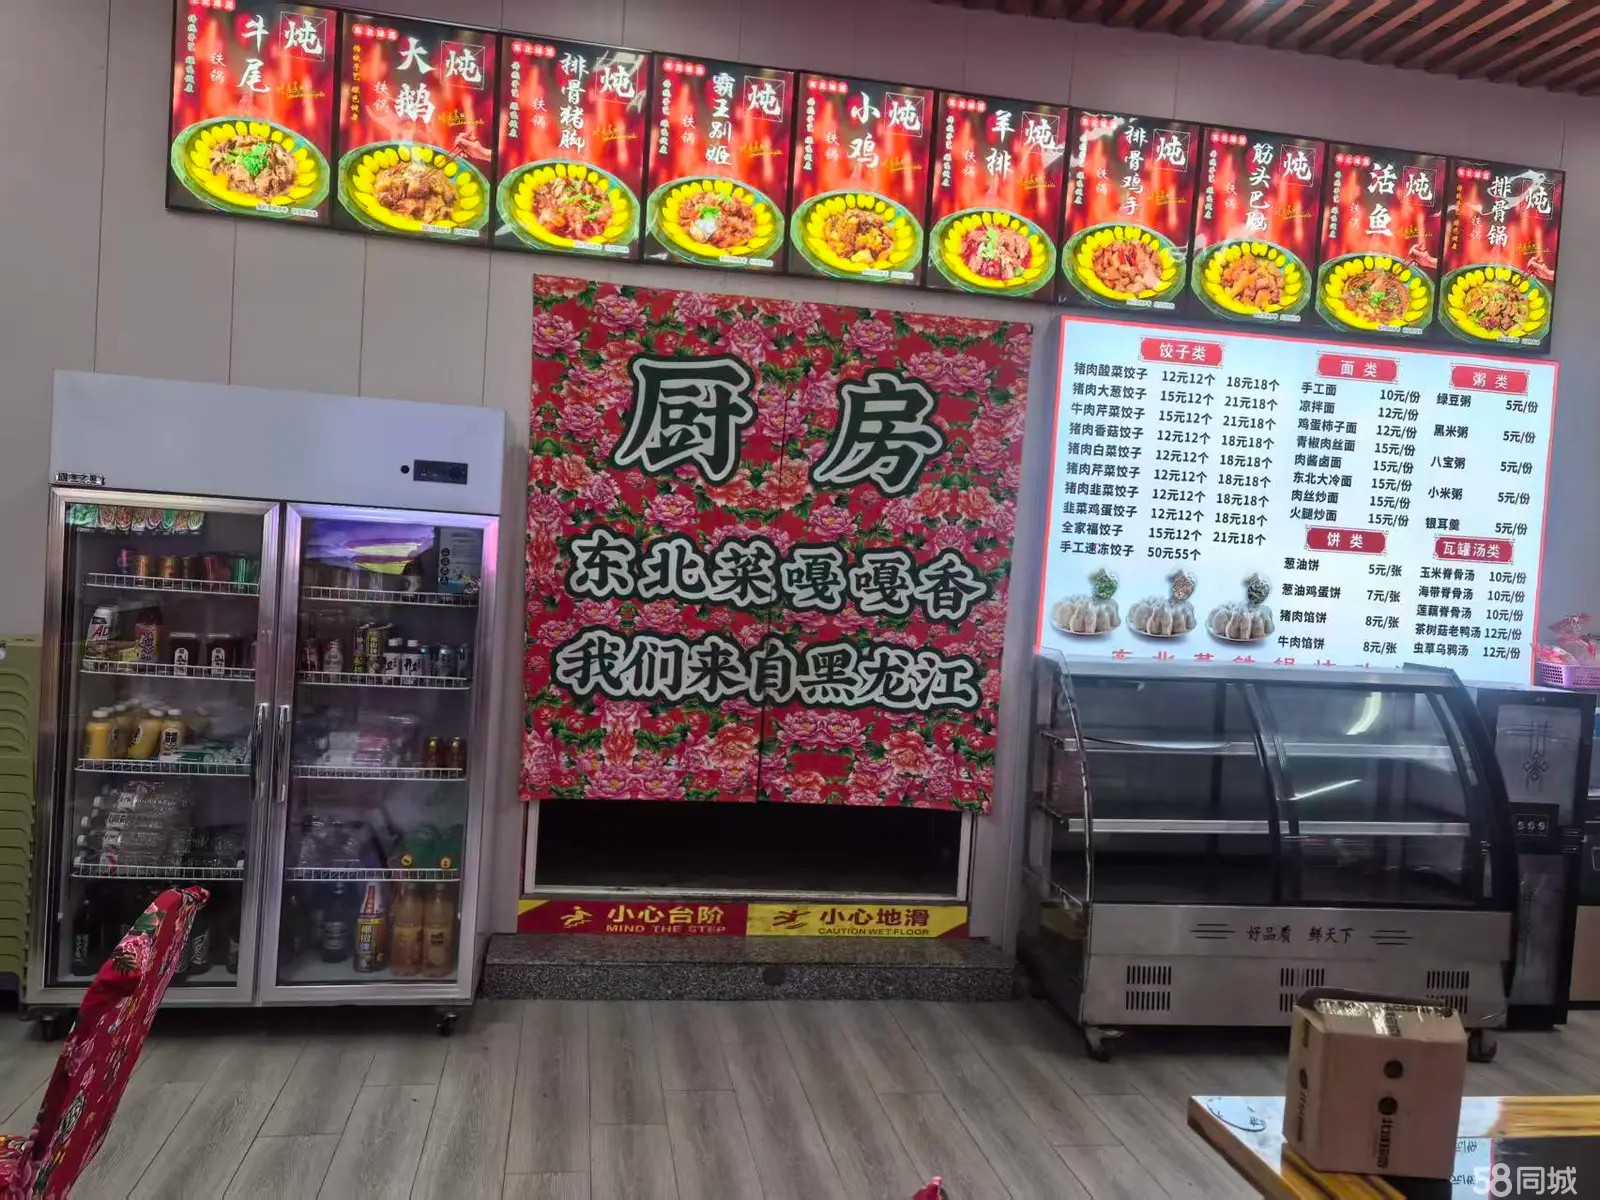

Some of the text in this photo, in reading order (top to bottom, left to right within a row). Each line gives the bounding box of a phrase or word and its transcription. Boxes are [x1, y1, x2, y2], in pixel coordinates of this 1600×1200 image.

[284, 20, 323, 55] 炖
[237, 15, 270, 93] 牛尾
[444, 48, 481, 82] 炖
[394, 36, 436, 125] 大鹅
[600, 65, 635, 98] 炖
[747, 82, 781, 116] 炖
[706, 72, 735, 165] 霸王别姬
[889, 99, 921, 131] 炖
[848, 91, 881, 169] 小鸡
[1025, 118, 1057, 149] 炖
[985, 109, 1016, 181] 羊排
[1156, 135, 1186, 166] 炖
[1283, 151, 1312, 180] 炖
[1405, 172, 1433, 200] 炖
[1366, 162, 1397, 237] 活鱼
[1525, 186, 1551, 214] 炖
[1487, 176, 1513, 247] 排骨锅
[1158, 343, 1207, 362] 饺子类
[1074, 362, 1280, 392] 猪肉酸菜饺子 12元12个 18元18个
[1340, 359, 1377, 377] 面类
[1473, 371, 1508, 389] 粥类
[1072, 382, 1278, 412] 猪肉大葱饺子 15元12个 21元18个
[1301, 382, 1421, 404] 手工面 10元/份
[1437, 392, 1538, 414] 绿豆粥 5元/份
[1071, 402, 1276, 431] 牛肉芹菜饺子 15元12个 21元18个
[1299, 400, 1419, 421] 凉拌面 12元/份
[613, 355, 945, 496] 厨房
[1069, 422, 1275, 451] 猪肉香菇饺子 12元12个 18元18个
[1297, 418, 1417, 439] 鸡蛋柿子面 12元/份
[1434, 424, 1536, 444] 黑米粥 5元/份
[1068, 442, 1273, 470] 猪肉白菜饺子 12元12个 18元18个
[1296, 435, 1416, 457] 青椒肉丝面 15元/份
[1295, 454, 1414, 474] 肉酱卤面 15元/份
[1431, 455, 1533, 475] 八宝粥 5元/份
[1066, 462, 1271, 489] 猪肉芹菜饺子 12元12个 18元18个
[1293, 471, 1412, 493] 东北大冷面 15元/份
[1065, 481, 1269, 508] 猪肉韭菜饺子 12元12个 18元18个
[1291, 490, 1411, 510] 肉丝炒面 15元/份
[1428, 486, 1530, 505] 小米粥 5元/份
[1063, 501, 1268, 528] 韭菜鸡蛋饺子 12元12个 18元18个
[1290, 507, 1409, 528] 火腿炒面 15元/份
[1062, 521, 1266, 547] 全家福饺子 15元12个 21元18个
[1425, 517, 1528, 536] 银耳羹 5元/份
[1060, 541, 1201, 561] 手工速冻饺子 50元55个
[1327, 531, 1364, 549] 饼类
[1443, 541, 1500, 559] 瓦罐汤类
[567, 529, 990, 619] 东北菜嘎嘎香
[1284, 557, 1402, 578] 葱油饼 5元/张
[1419, 566, 1527, 585] 玉米脊骨汤 10元/份
[1282, 583, 1401, 603] 葱油鸡蛋饼 7元/张
[1418, 585, 1525, 603] 海带脊骨汤 10元/份
[1280, 609, 1400, 629] 猪肉馅饼 8元/张
[1416, 604, 1524, 622] 莲藕脊骨汤 10元/份
[1415, 622, 1522, 641] 茶树菇老鸭汤 12元/份
[1277, 635, 1397, 655] 牛肉馅饼 8元/张
[1483, 646, 1521, 660] 12元/份
[552, 628, 982, 712] 我们来自黑龙江
[607, 904, 724, 924] 小心台阶
[820, 908, 930, 927] 小心地滑
[606, 924, 726, 934] MIND THE STEP
[818, 927, 866, 935] CAUTION
[1308, 925, 1354, 944] 鲜天下
